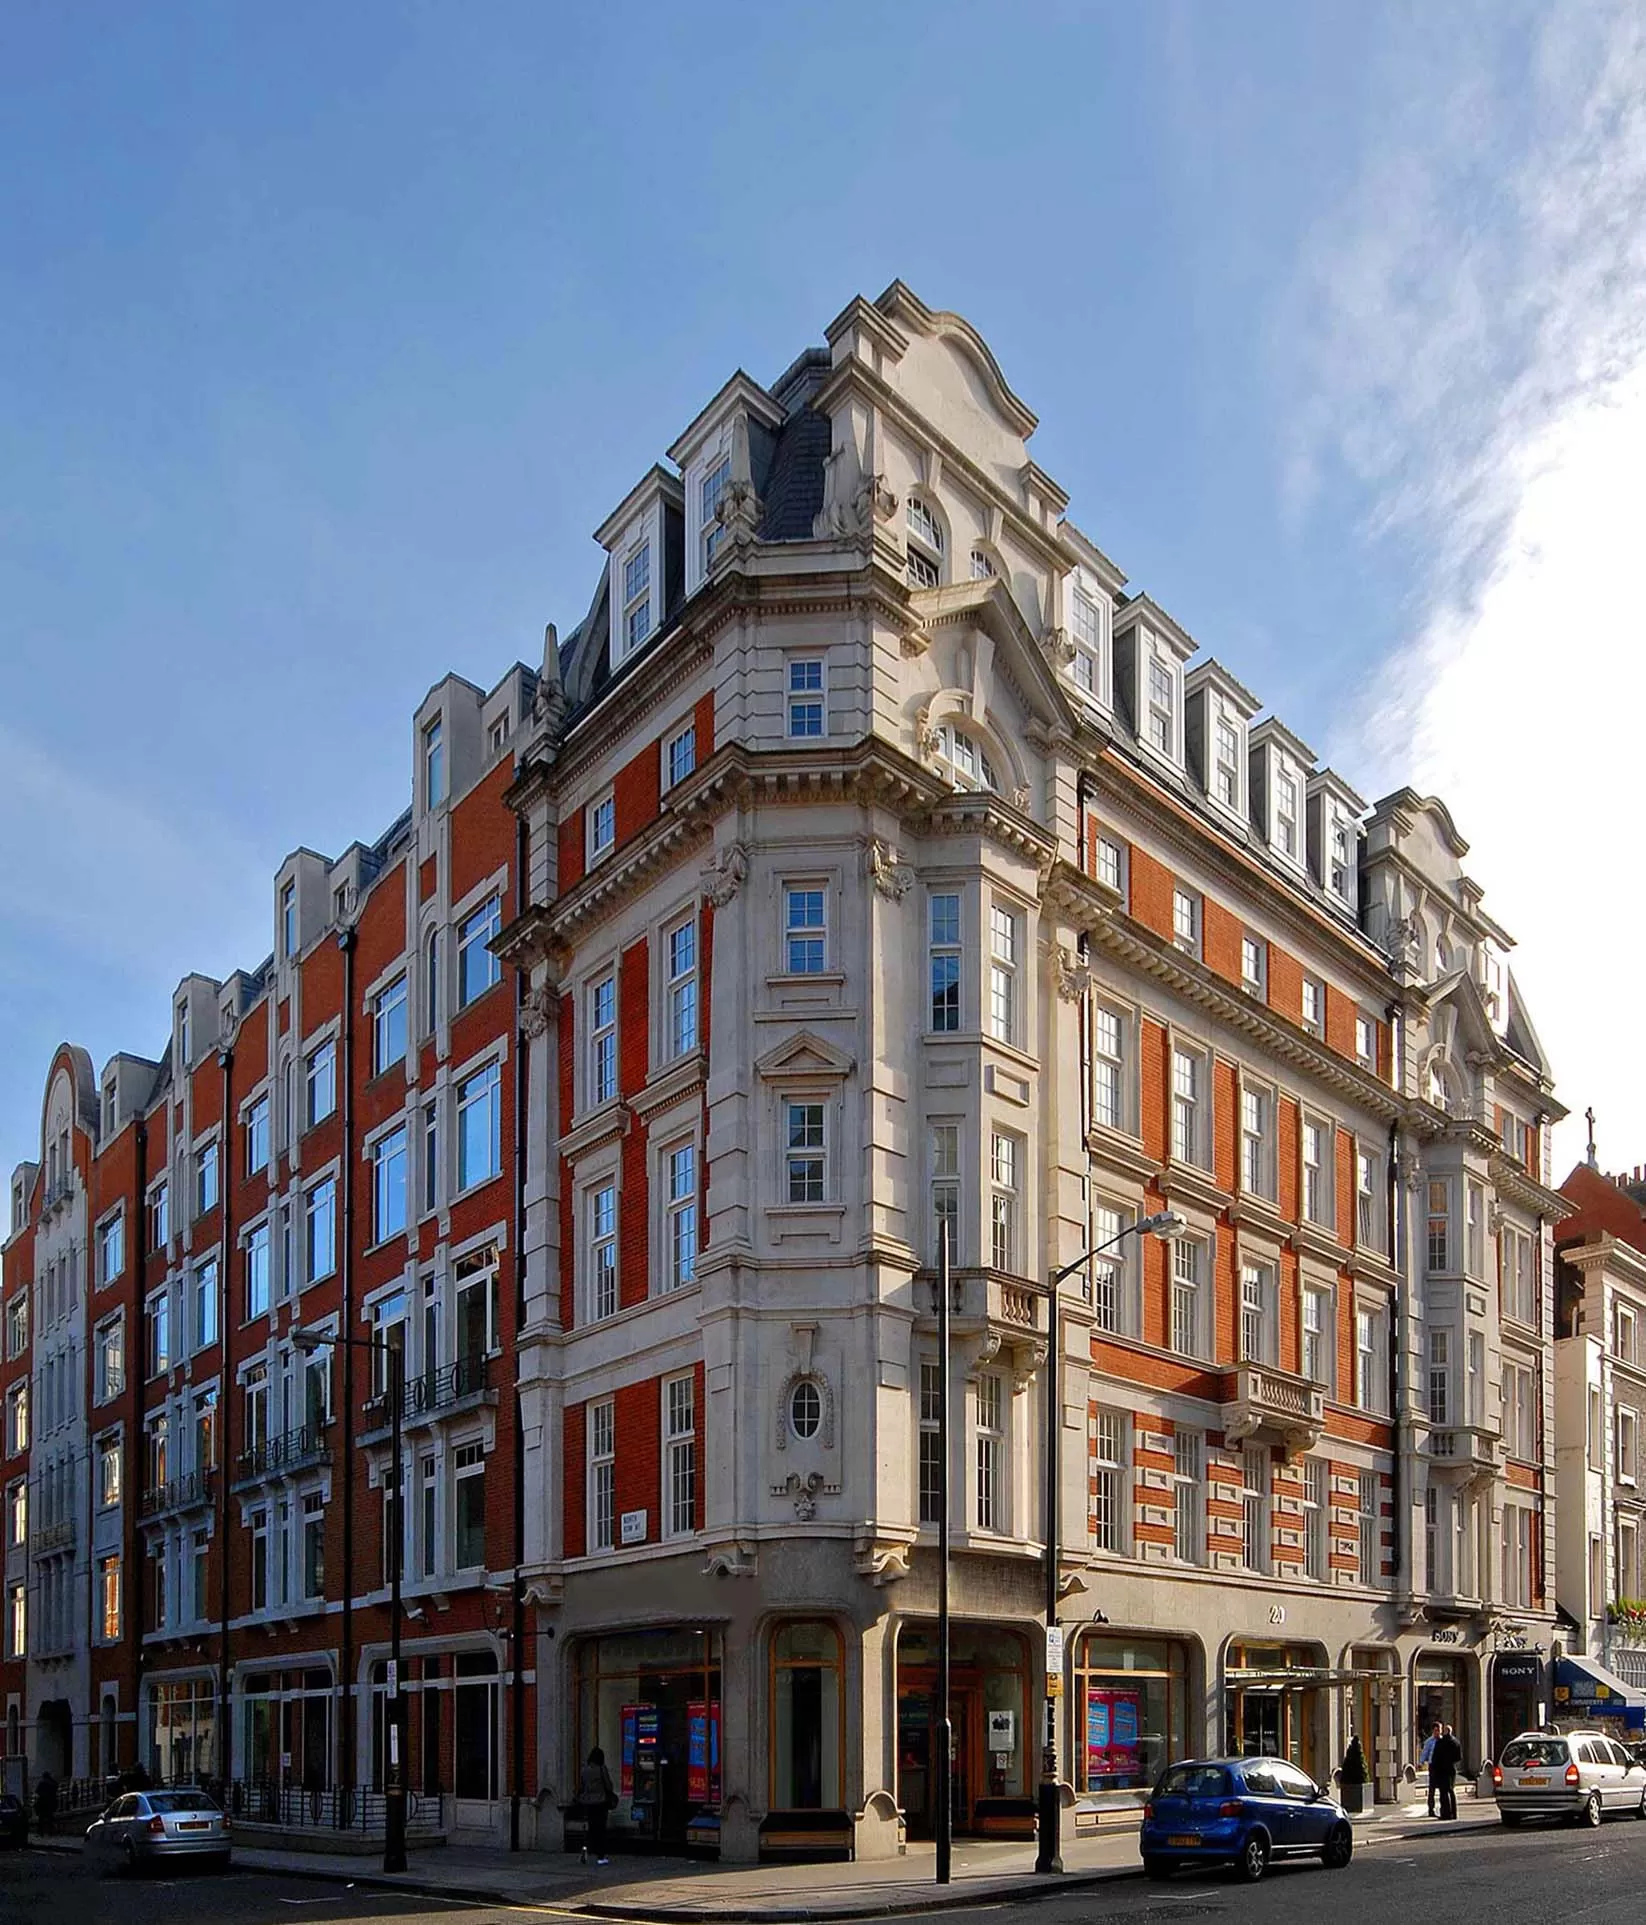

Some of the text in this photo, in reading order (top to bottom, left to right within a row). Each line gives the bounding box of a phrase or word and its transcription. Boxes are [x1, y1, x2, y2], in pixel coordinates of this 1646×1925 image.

[1269, 1605, 1286, 1624] 20
[1432, 1629, 1459, 1643] SONY
[1501, 1667, 1535, 1675] SONY
